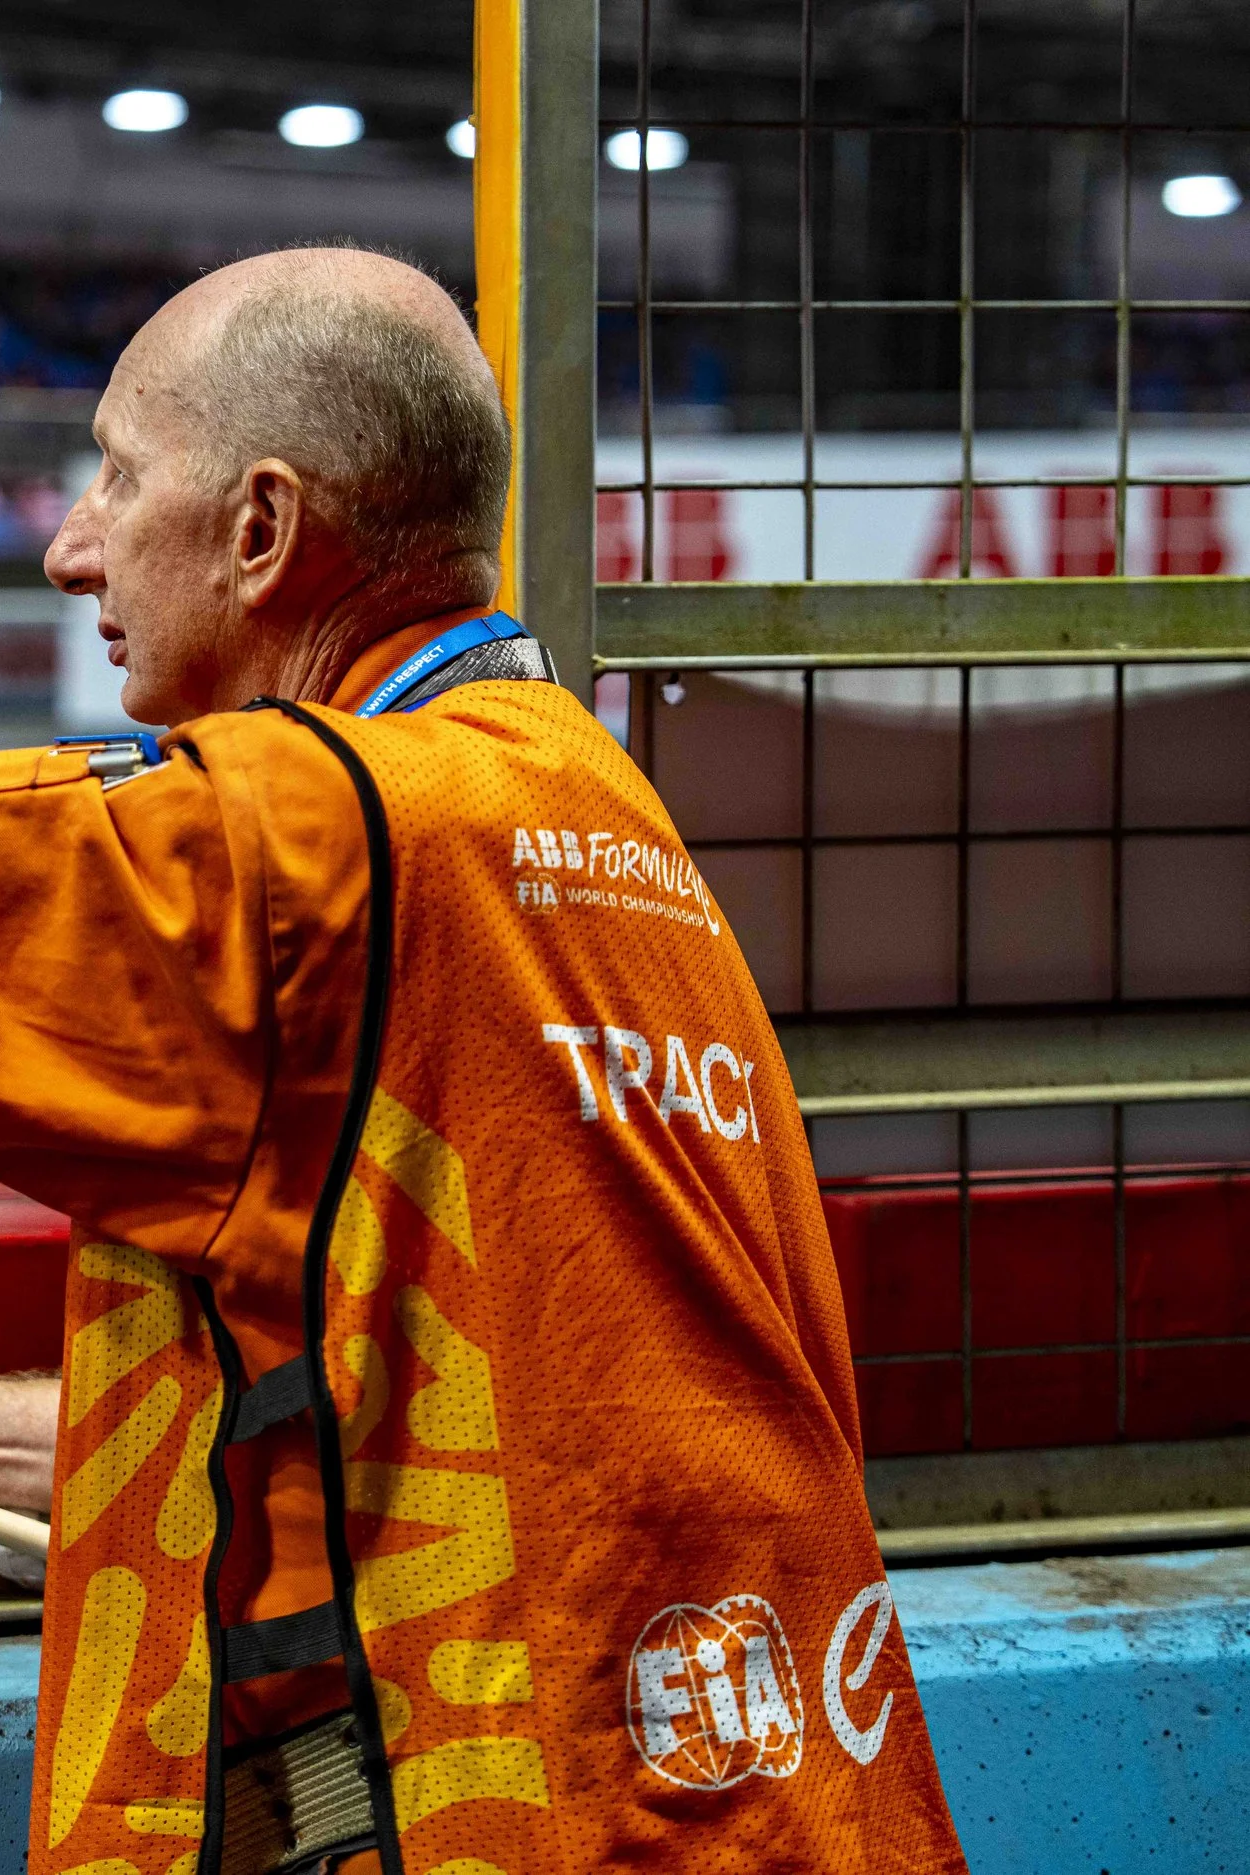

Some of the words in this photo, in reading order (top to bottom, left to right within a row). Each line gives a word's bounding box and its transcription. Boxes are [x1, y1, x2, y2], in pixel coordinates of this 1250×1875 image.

[366, 682, 398, 711] WITH
[394, 645, 444, 684] RESPECT
[512, 828, 583, 869] ABB
[566, 888, 617, 907] WORLD
[622, 895, 705, 927] CHAMPIONSHIP
